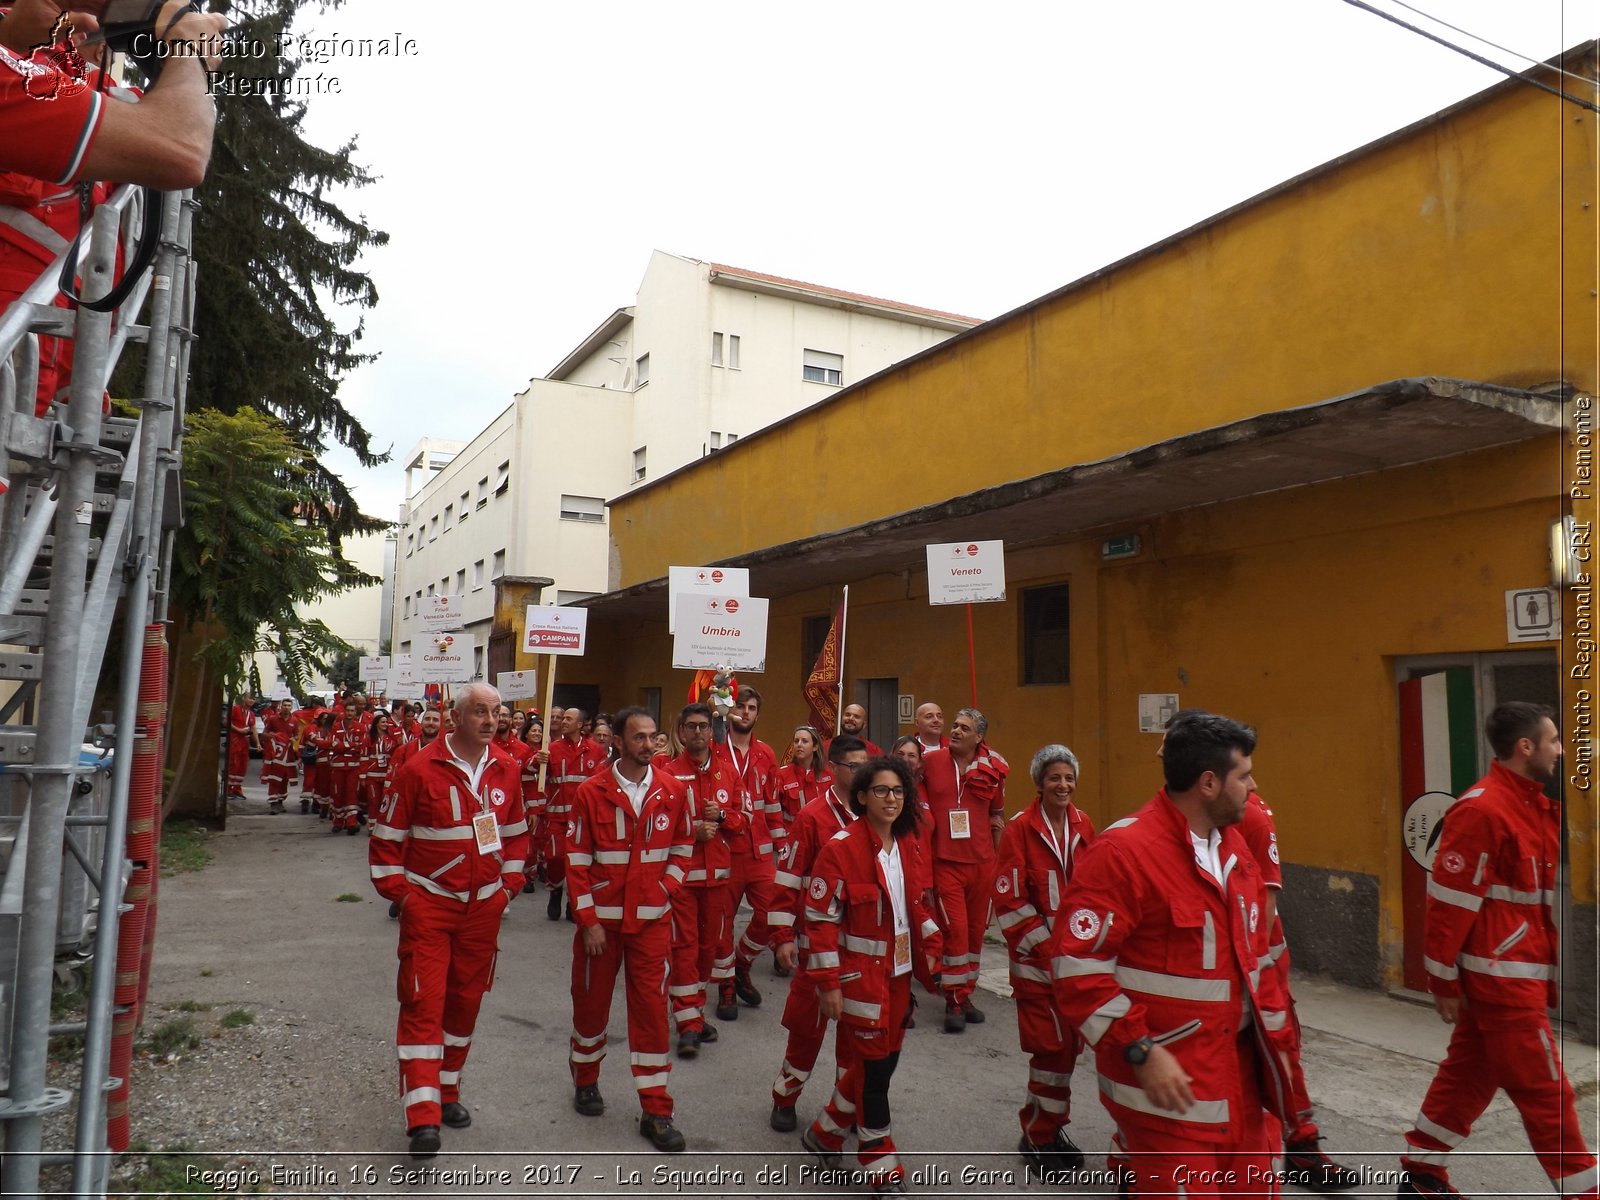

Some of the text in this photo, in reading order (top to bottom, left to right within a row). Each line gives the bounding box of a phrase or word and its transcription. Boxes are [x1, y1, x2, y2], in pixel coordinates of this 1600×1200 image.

[950, 568, 982, 576] Veneto
[701, 626, 741, 637] Umbria
[541, 634, 579, 643] CAMPANIA
[423, 654, 461, 663] Campania
